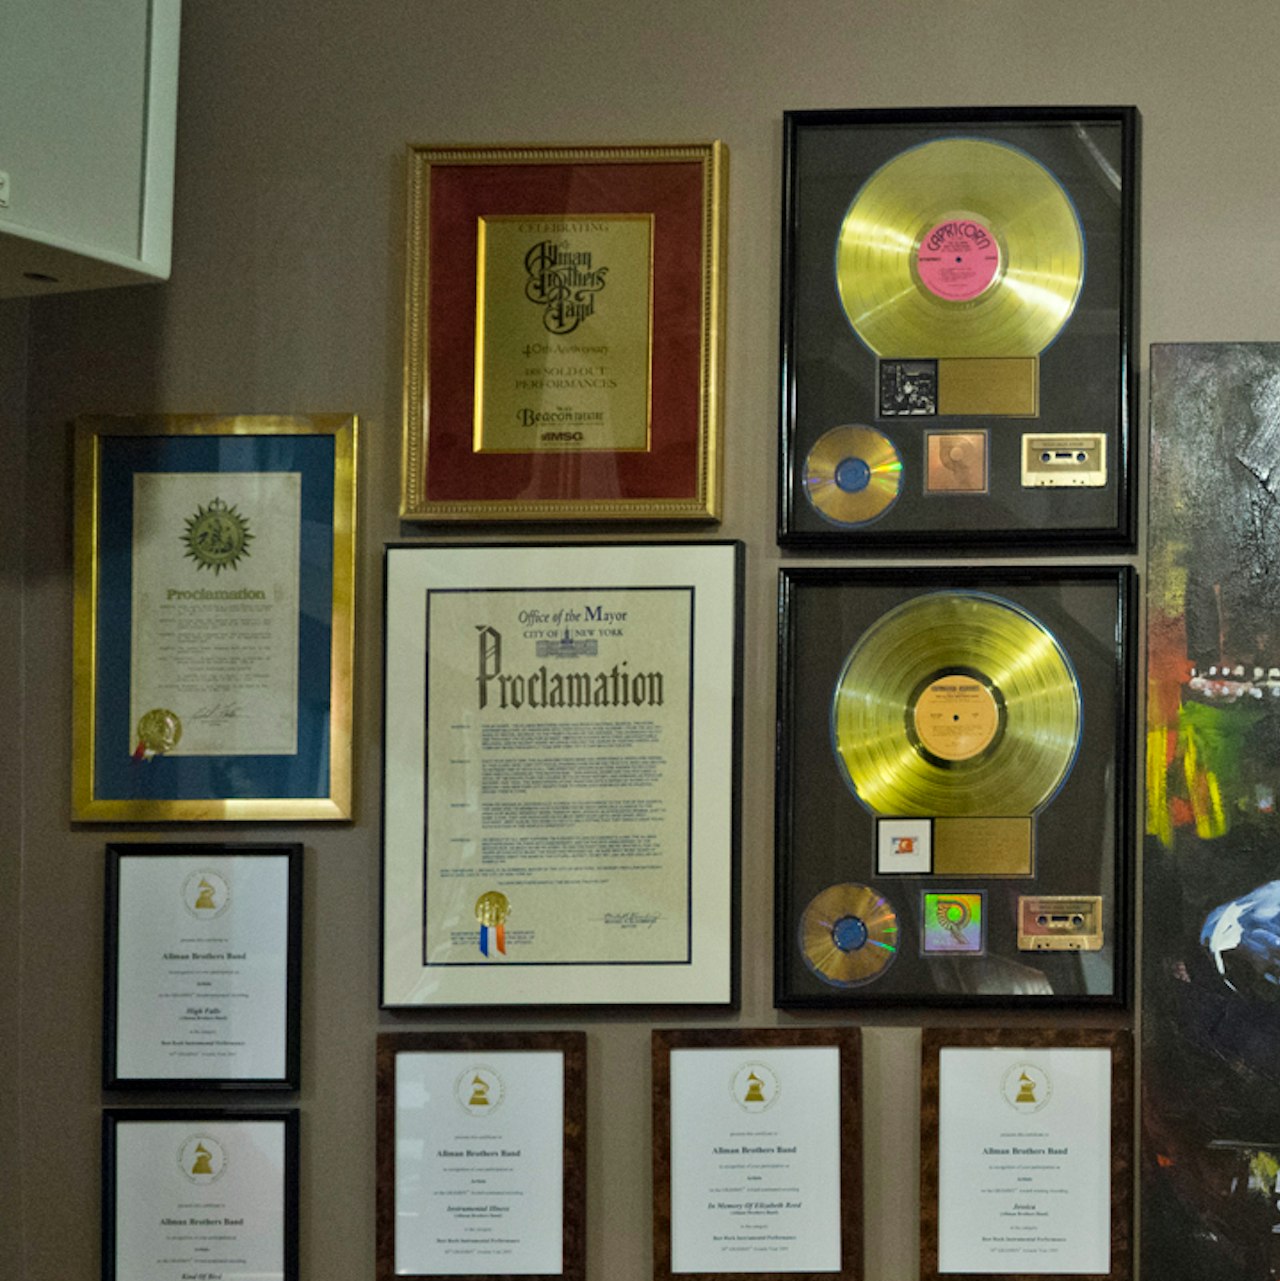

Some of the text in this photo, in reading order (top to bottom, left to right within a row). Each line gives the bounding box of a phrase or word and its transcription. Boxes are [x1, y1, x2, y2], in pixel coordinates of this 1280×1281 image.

[519, 222, 610, 233] CELEBRATING
[514, 378, 618, 390] PERFORMANCES
[165, 588, 267, 601] Proclamation
[518, 605, 629, 627] Office of the Mayor
[522, 627, 625, 640] CITY OF NEW YORK
[475, 624, 664, 711] Proclamation
